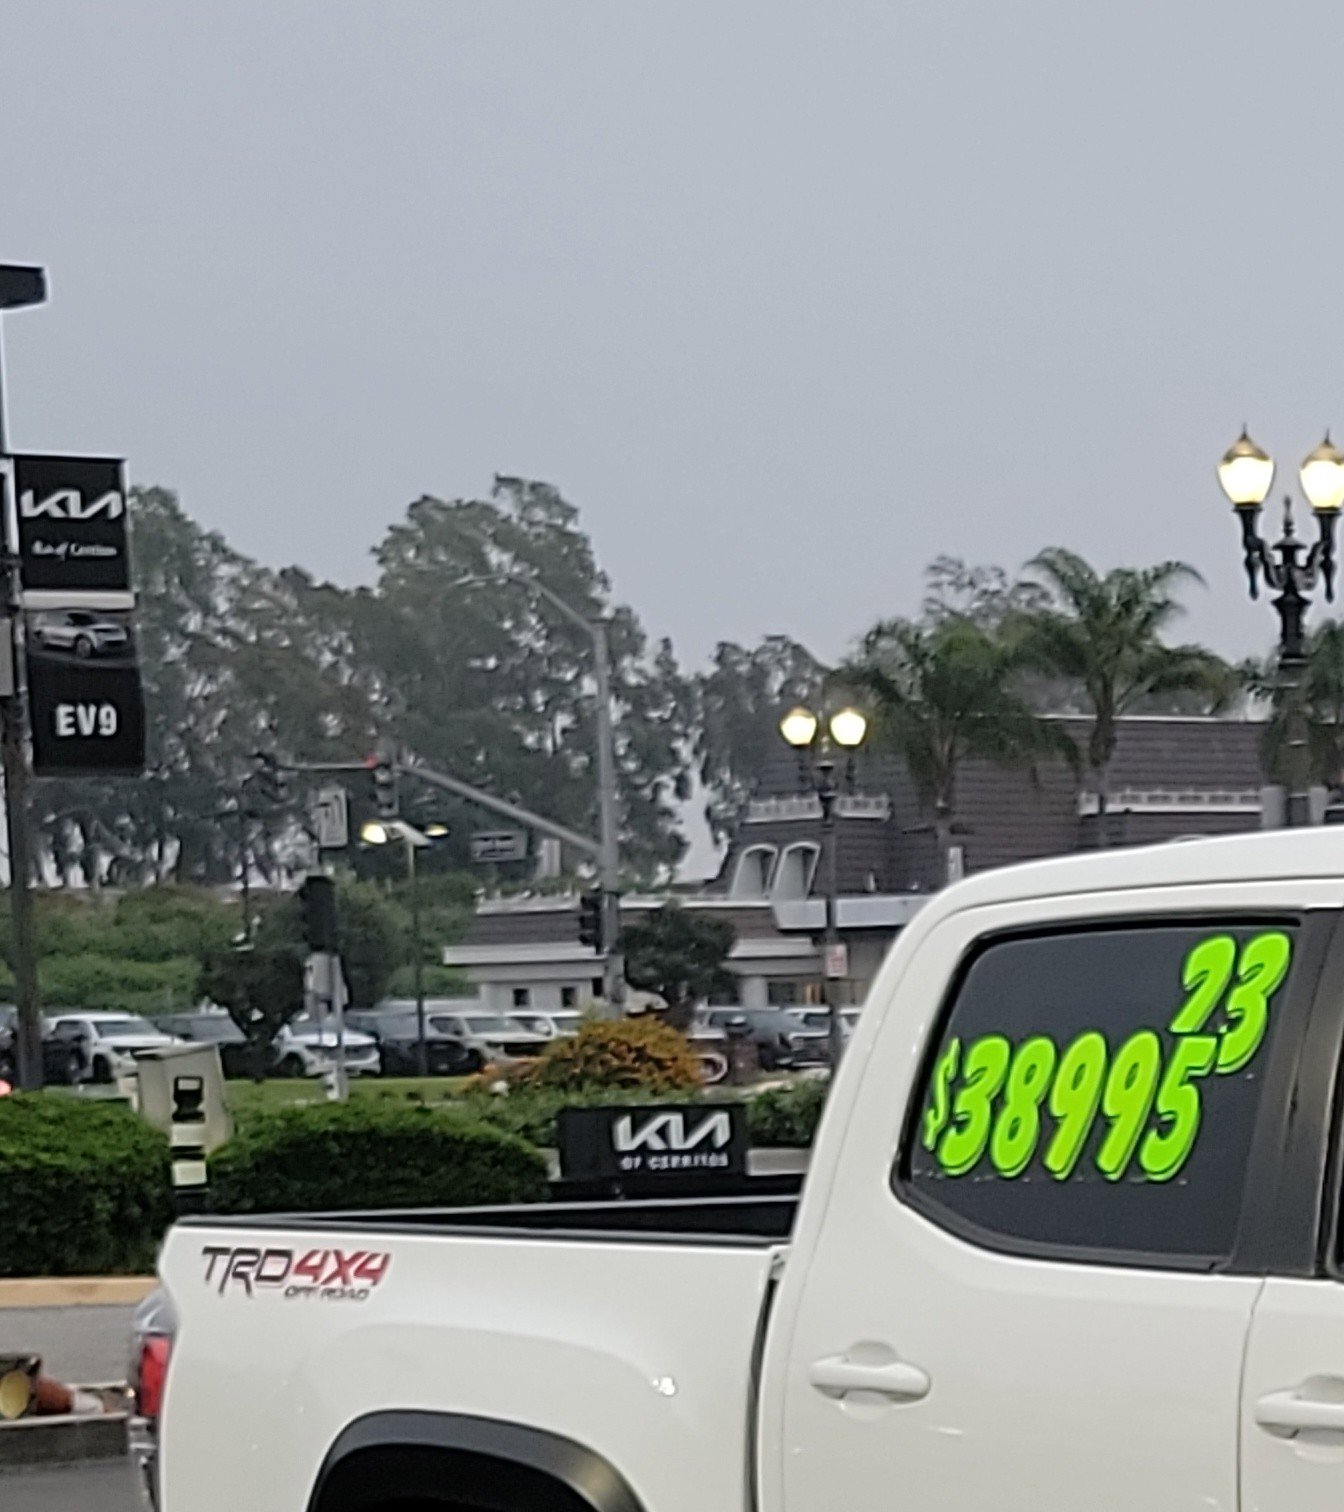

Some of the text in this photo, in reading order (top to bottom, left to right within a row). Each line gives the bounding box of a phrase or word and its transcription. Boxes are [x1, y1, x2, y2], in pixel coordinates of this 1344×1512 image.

[20, 488, 123, 519] KIA
[56, 703, 118, 736] EV9
[1170, 932, 1291, 1074] 23
[923, 1029, 1218, 1181] $38995
[613, 1110, 732, 1151] KIA
[202, 1245, 296, 1297] TRD
